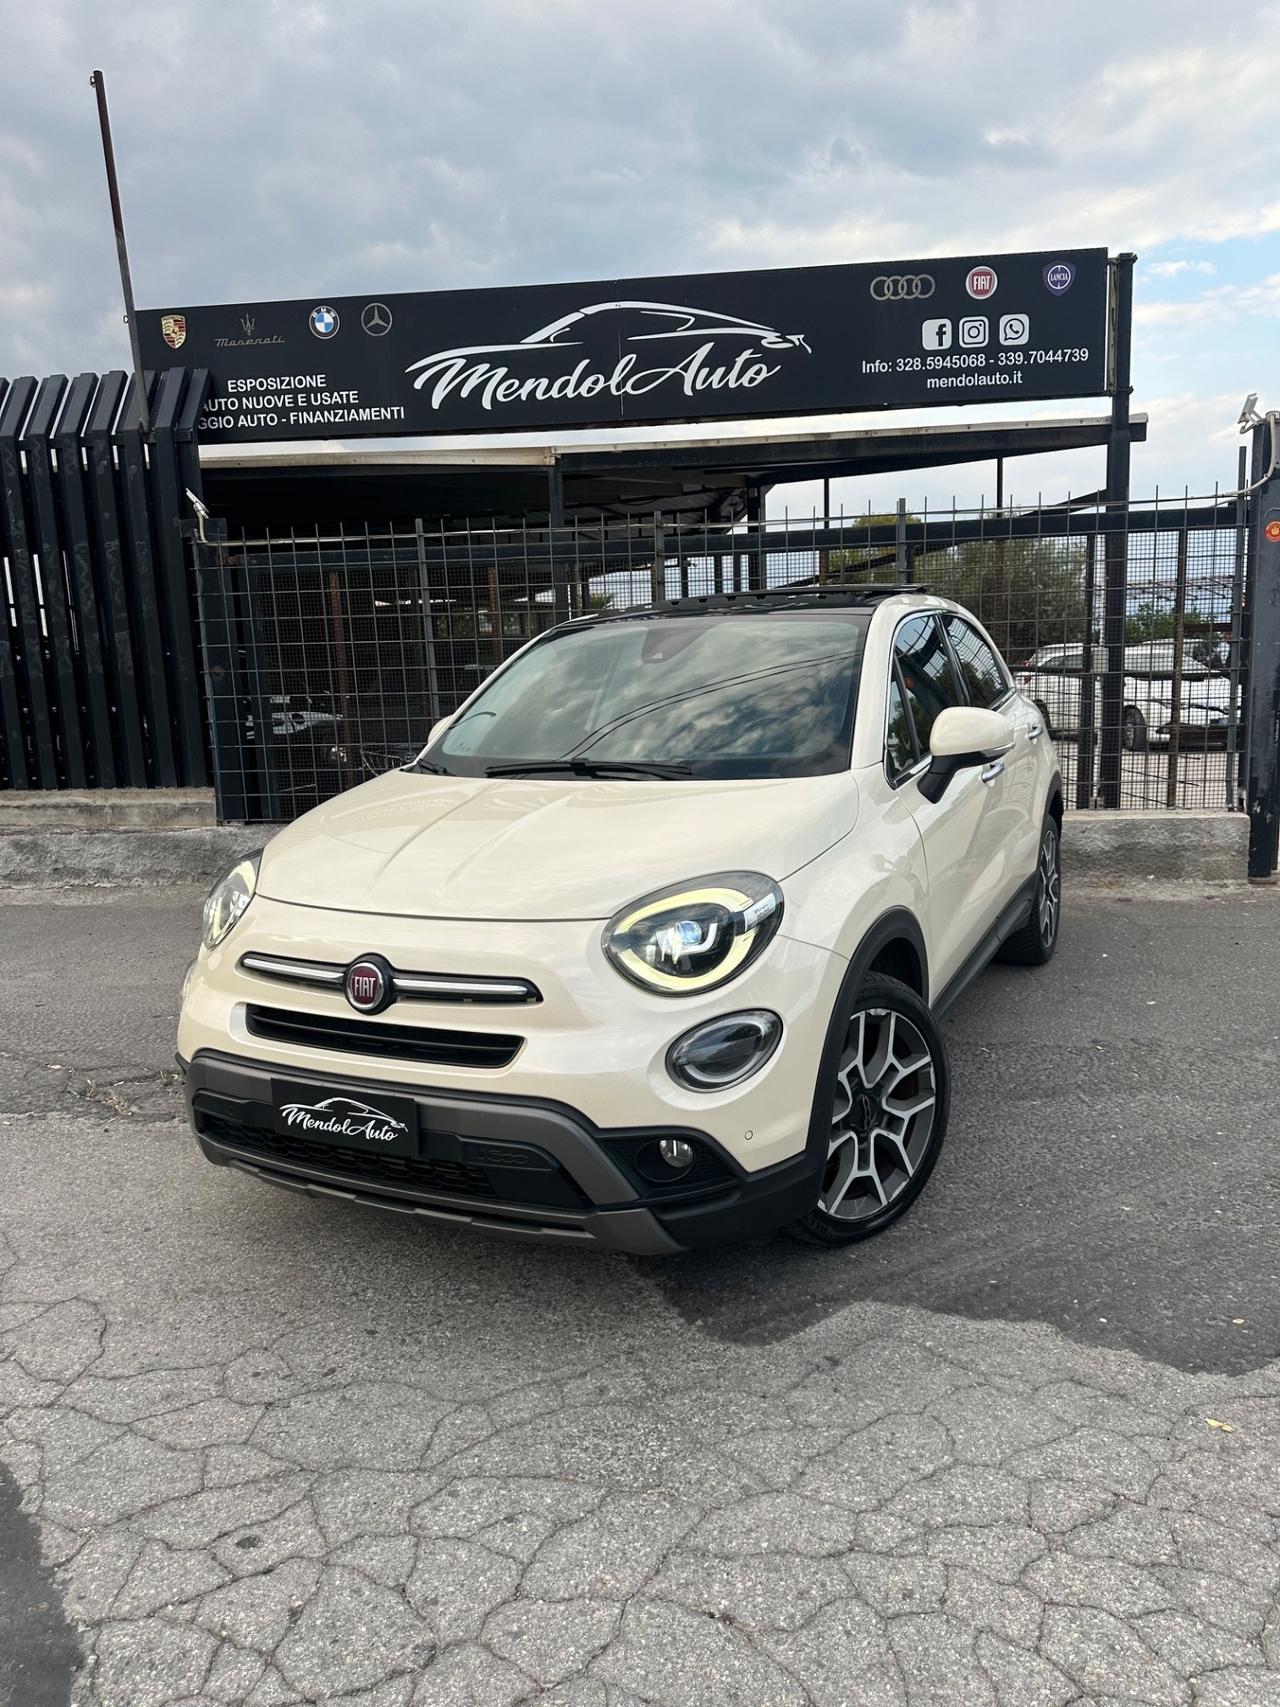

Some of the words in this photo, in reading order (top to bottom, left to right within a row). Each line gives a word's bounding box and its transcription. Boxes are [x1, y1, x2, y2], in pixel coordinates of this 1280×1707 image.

[973, 275, 991, 291] FIAT
[212, 335, 286, 348] Maserati
[861, 358, 893, 374] Info:
[895, 353, 986, 372] 328.5945068
[997, 348, 1089, 366] 339.7044739
[227, 374, 327, 393] ESPOSIZIONE
[413, 341, 782, 410] MendolAuto
[926, 371, 1023, 389] mendolauto.it
[242, 394, 295, 410] NUOVE
[298, 393, 308, 406] E
[310, 390, 359, 406] USATE
[198, 415, 235, 430] GGIO
[237, 413, 278, 428] AUTO
[289, 406, 405, 425] FINANZIAMENTI
[354, 976, 376, 998] FIAT
[281, 1107, 399, 1141] MendolAuto
